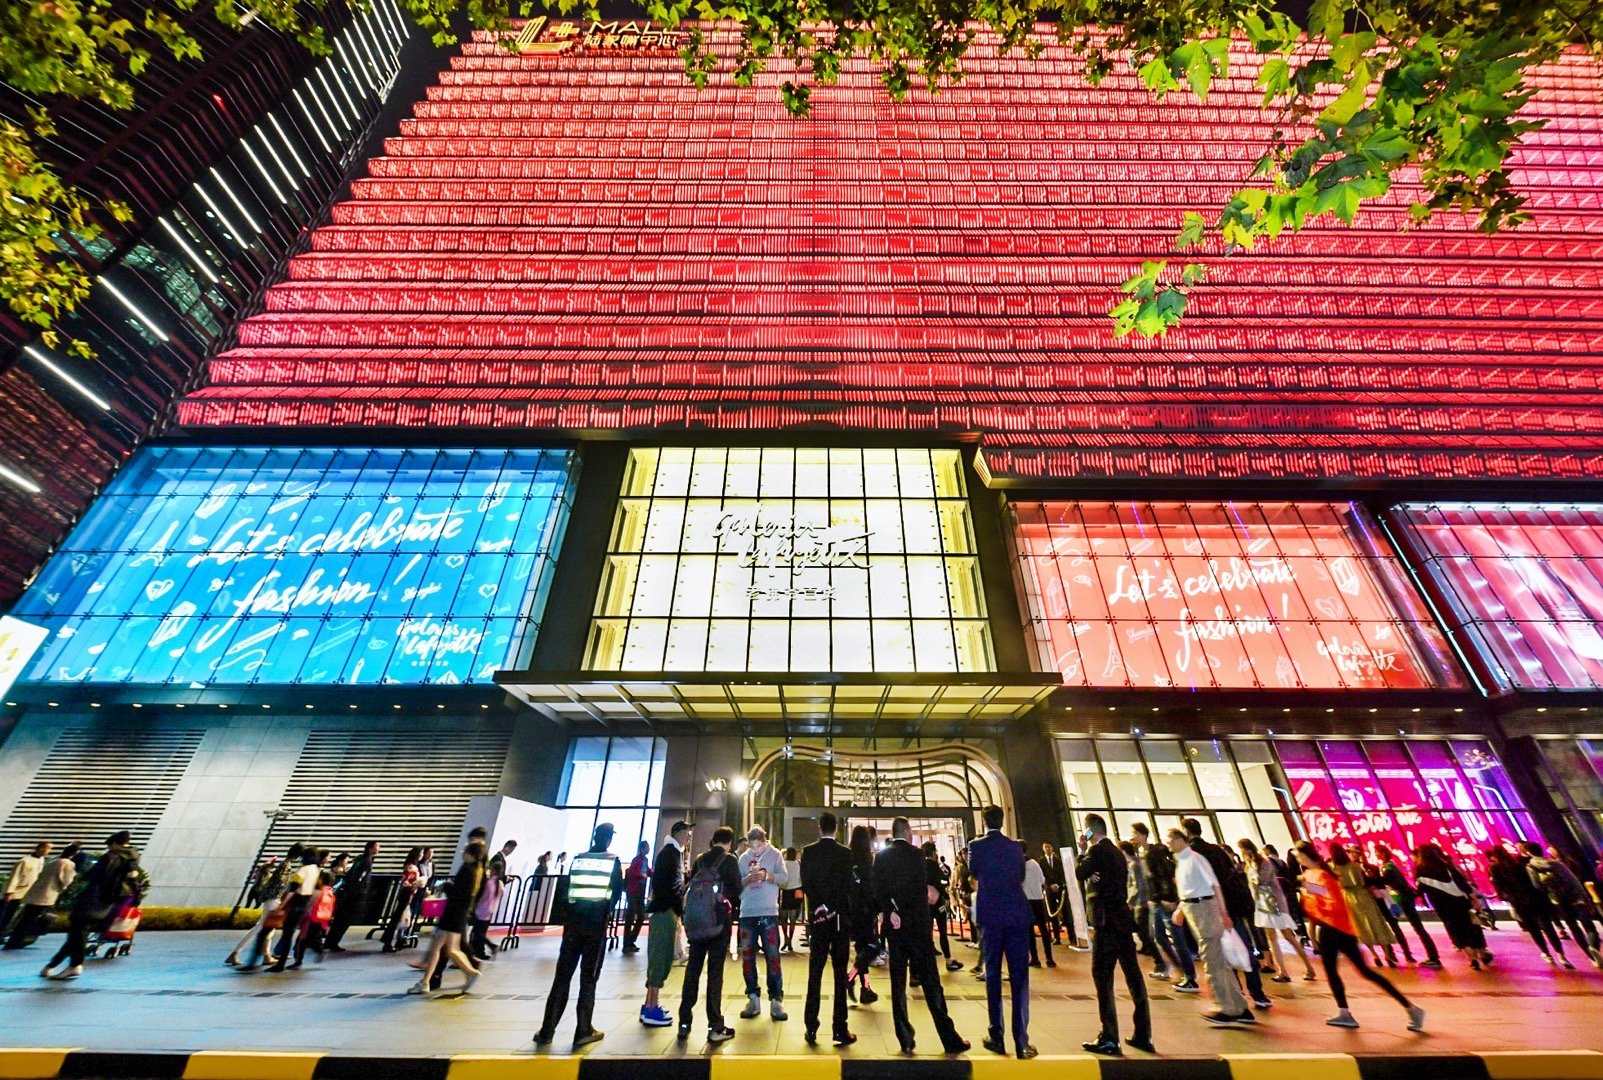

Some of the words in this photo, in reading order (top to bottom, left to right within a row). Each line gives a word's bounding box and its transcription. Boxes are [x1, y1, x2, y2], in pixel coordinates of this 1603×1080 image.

[583, 35, 677, 47] 陆家嘴中心
[588, 20, 680, 35] MALL
[187, 511, 299, 568] Let's
[299, 507, 472, 557] celebrate
[1108, 559, 1179, 606] Let's
[1183, 556, 1298, 597] celebrate
